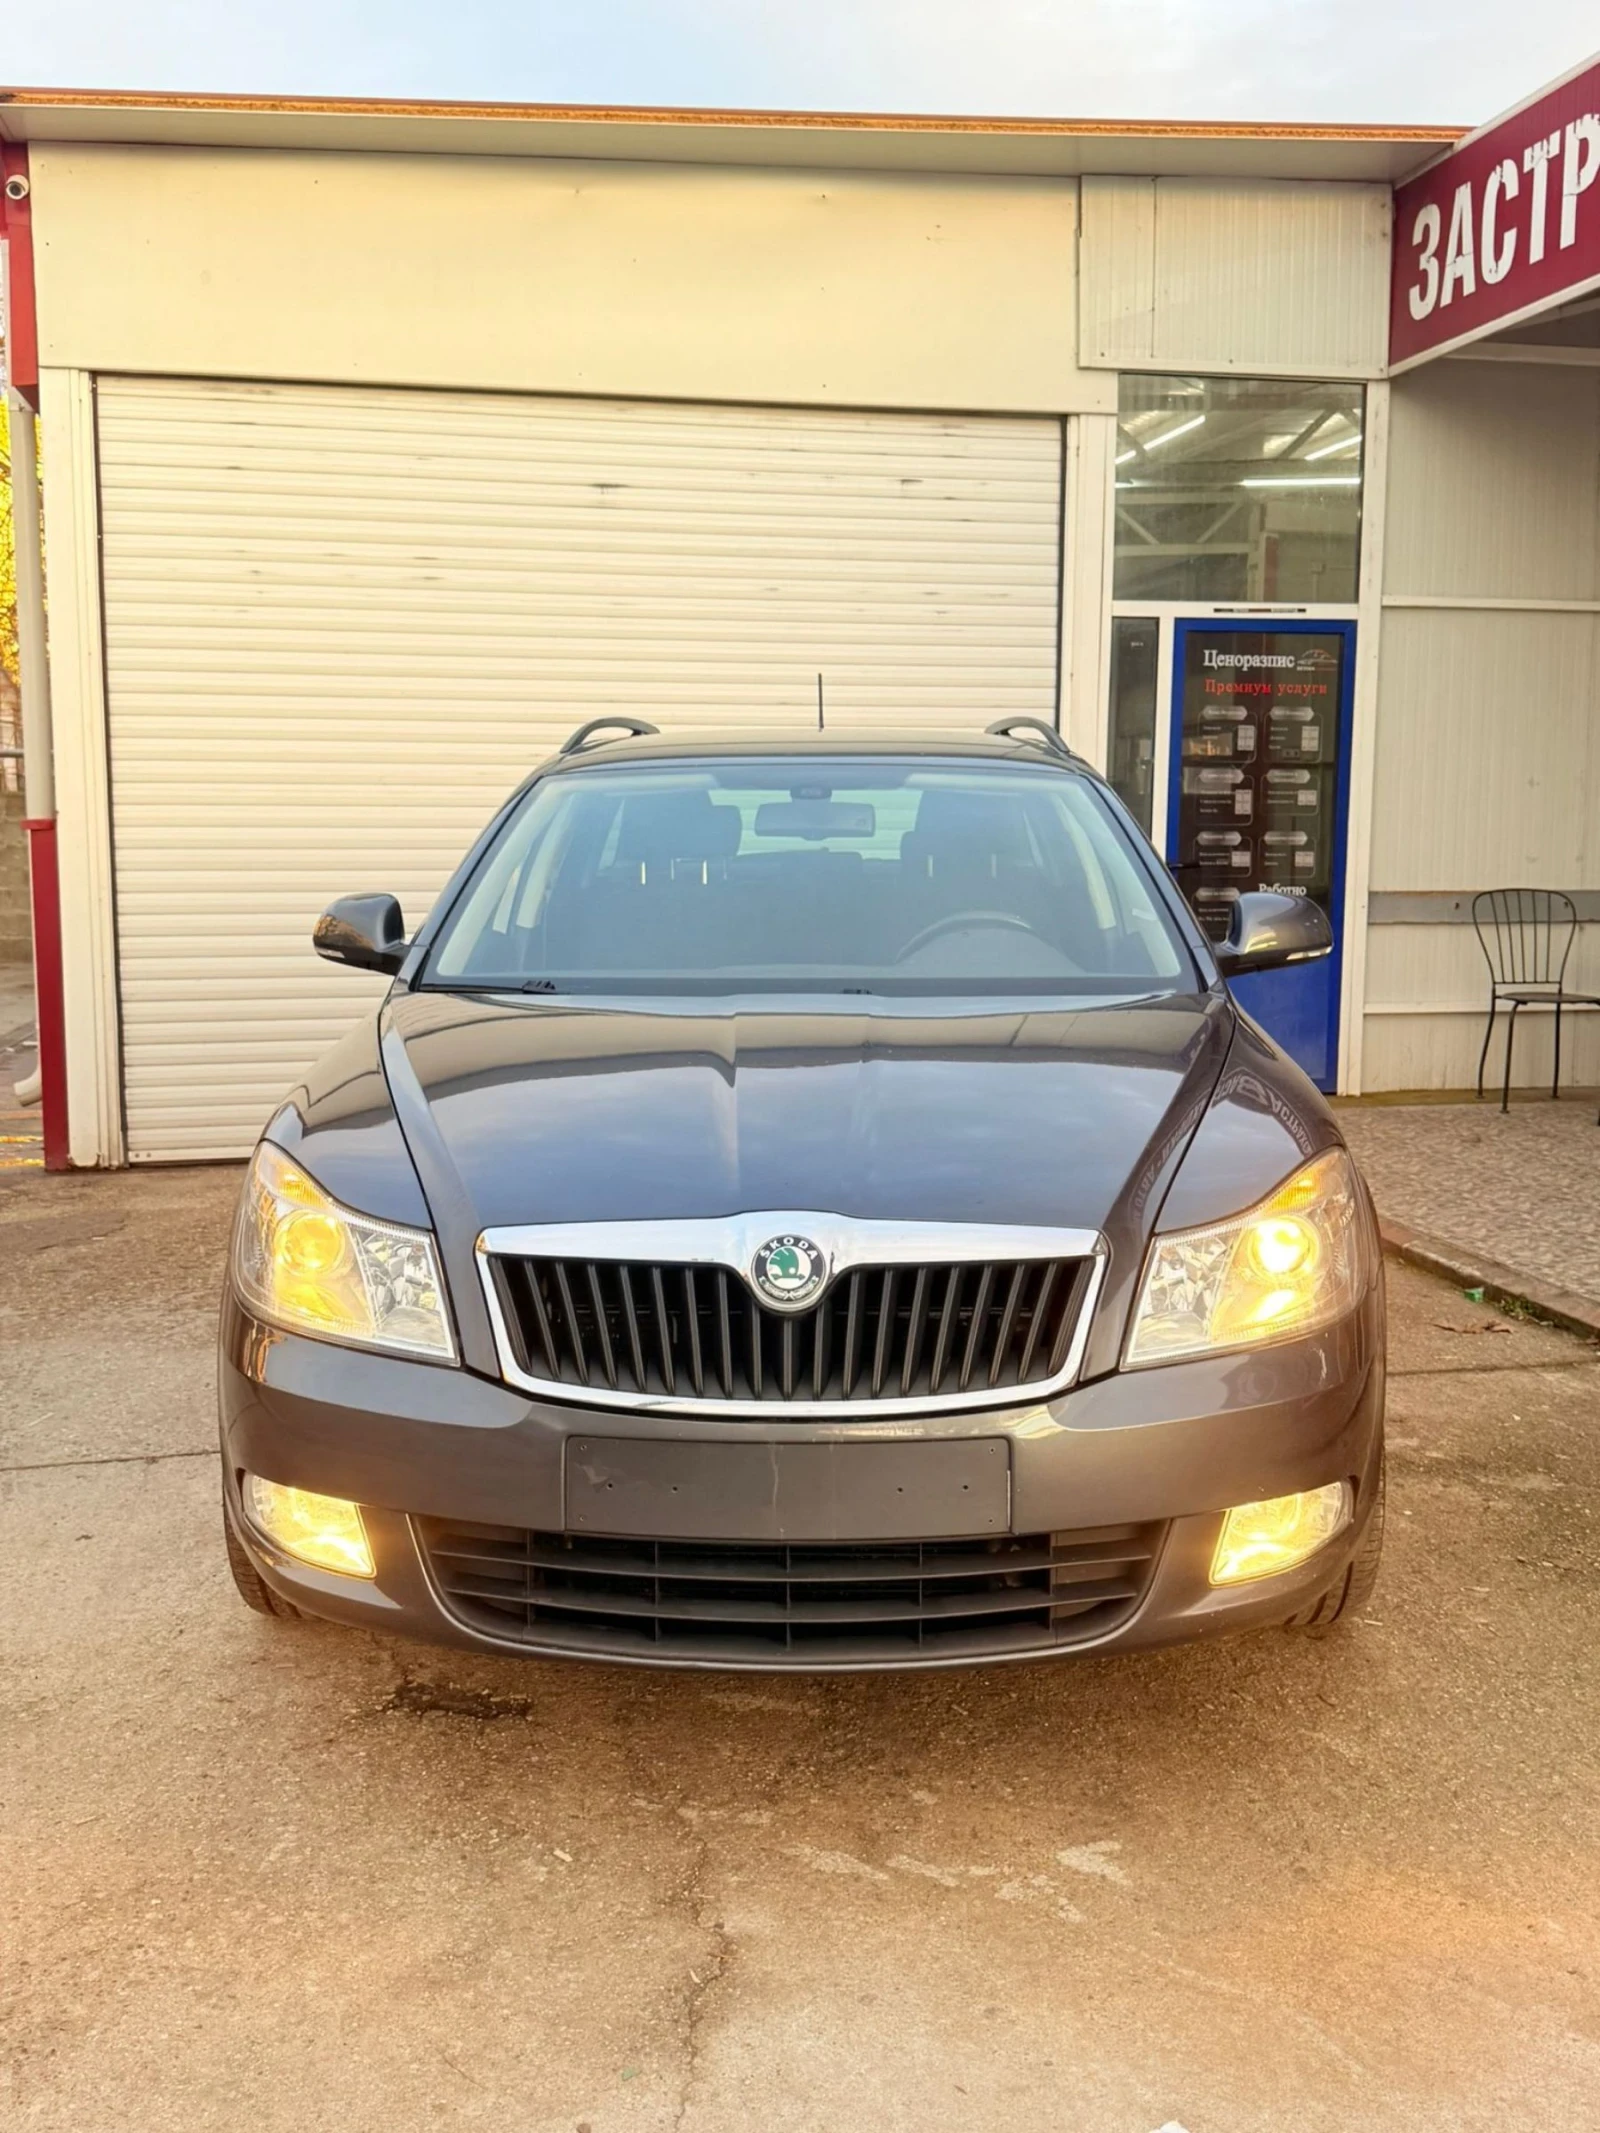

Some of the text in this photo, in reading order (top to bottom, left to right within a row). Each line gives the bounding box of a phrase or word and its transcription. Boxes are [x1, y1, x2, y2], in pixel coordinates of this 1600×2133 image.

[1409, 113, 1600, 321] ЗАСТР
[1203, 649, 1295, 671] Ценоразпис
[1204, 679, 1328, 696] Премиум услуги
[1258, 883, 1307, 896] Работно
[760, 1236, 818, 1260] SKODA
